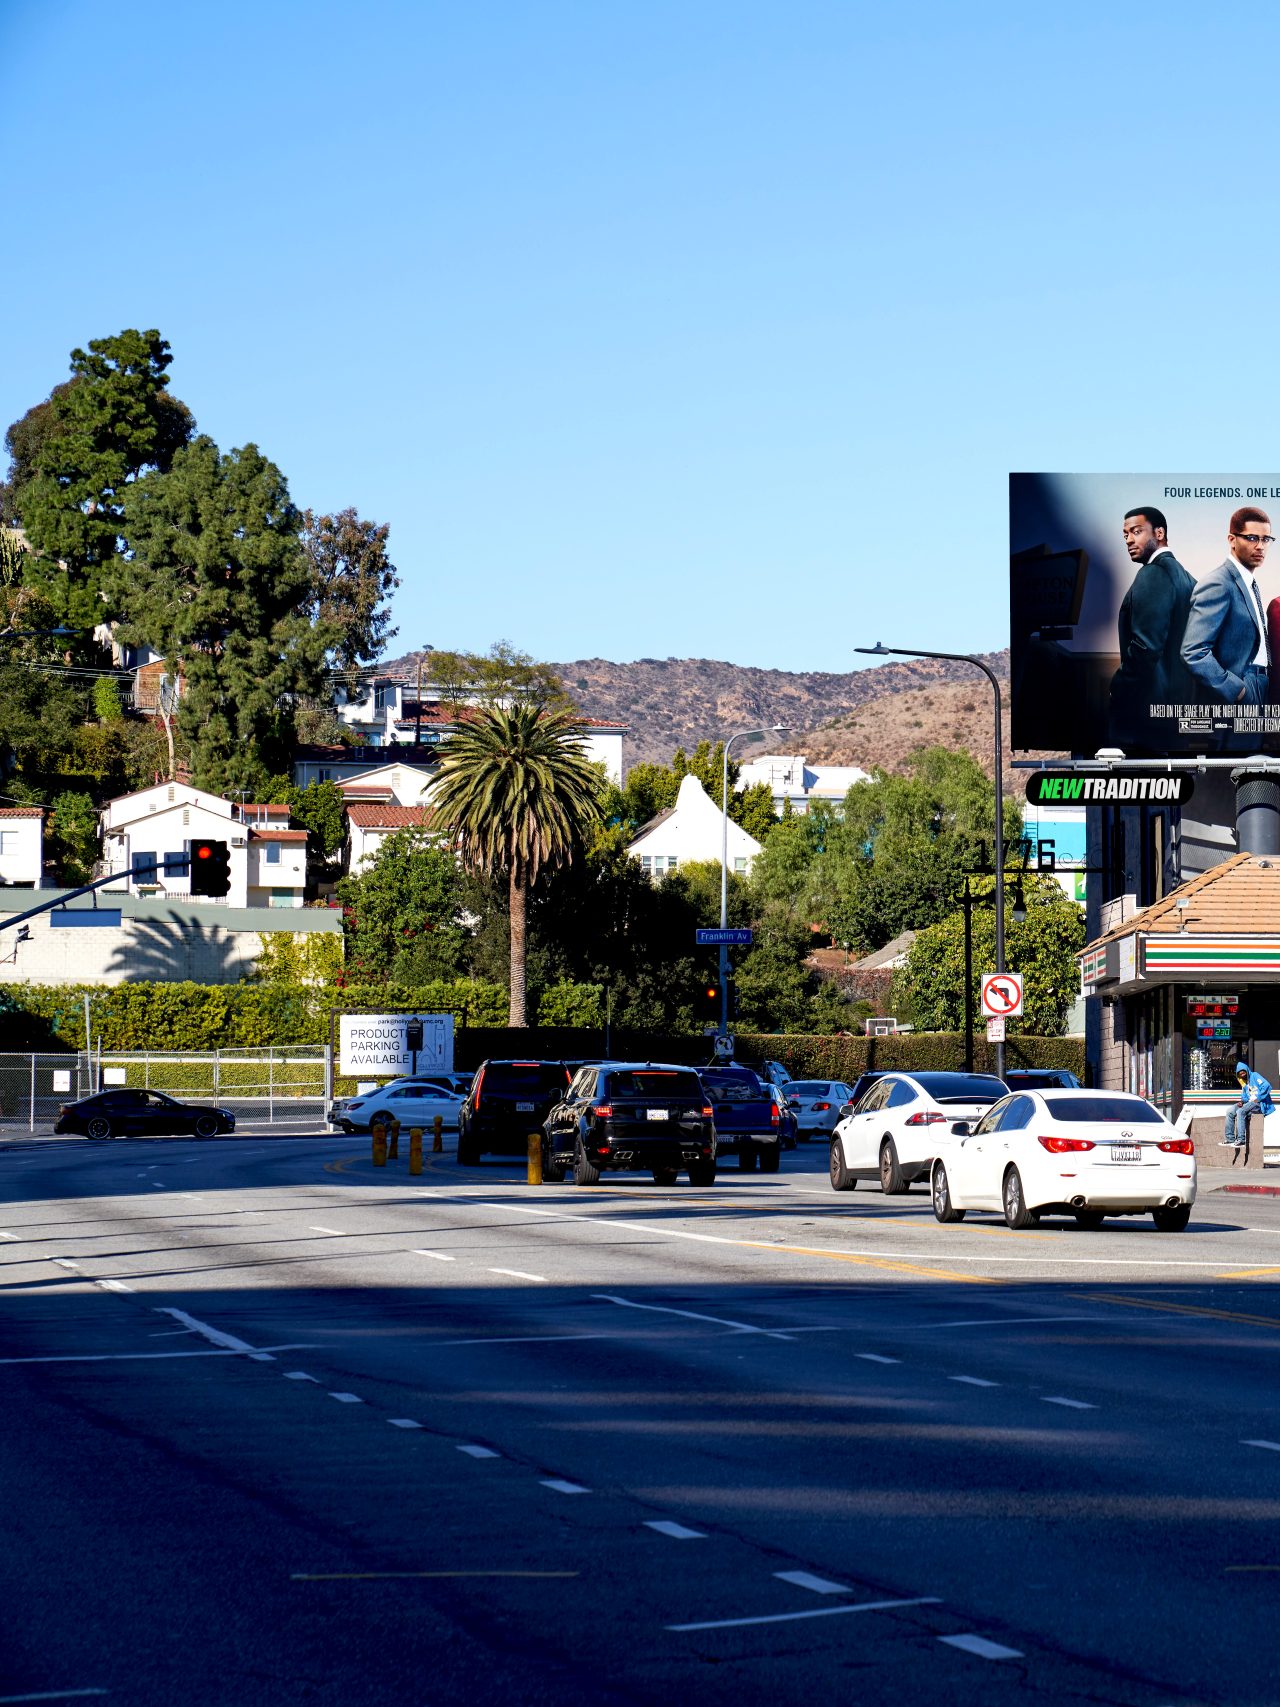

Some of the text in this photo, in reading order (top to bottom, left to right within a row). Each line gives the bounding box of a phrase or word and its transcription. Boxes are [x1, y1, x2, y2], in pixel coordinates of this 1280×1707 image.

[1164, 487, 1191, 498] FOUR
[1194, 487, 1244, 498] LEGENDS.
[1246, 488, 1268, 498] ONE
[350, 1042, 400, 1050] PARKING
[350, 1054, 410, 1064] AVAILABLE
